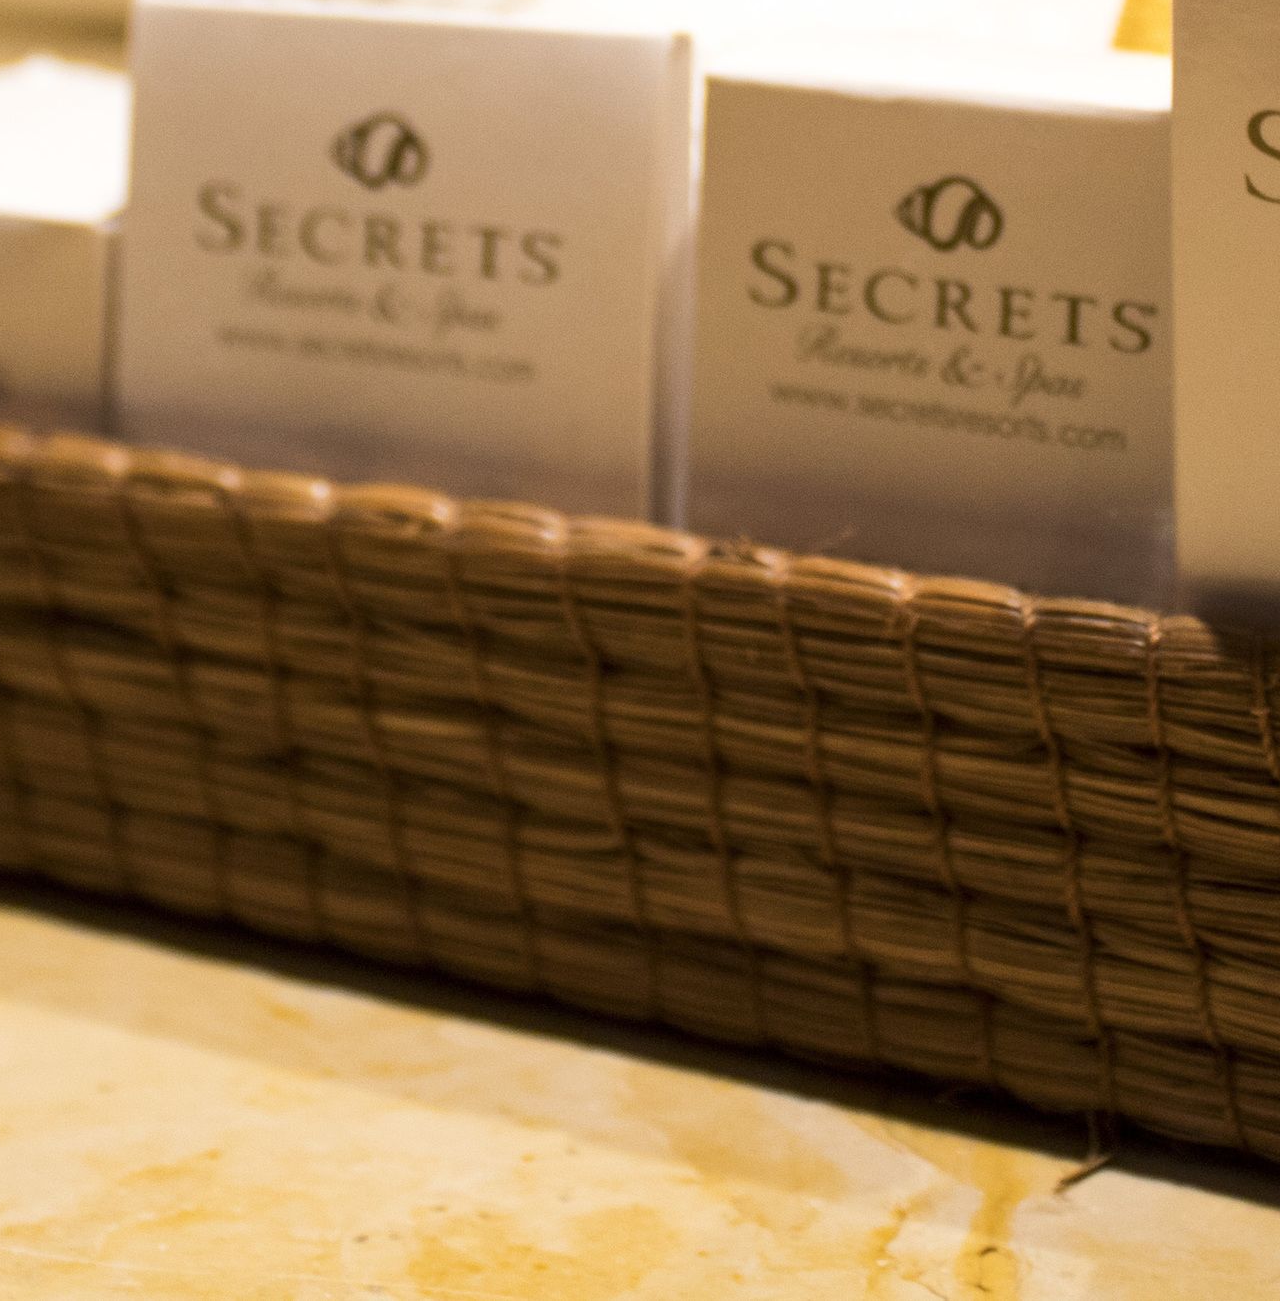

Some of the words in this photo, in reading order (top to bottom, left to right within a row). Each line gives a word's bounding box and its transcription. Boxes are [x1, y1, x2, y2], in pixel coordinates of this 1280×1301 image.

[194, 179, 564, 287] SECRETS
[746, 236, 1160, 355] SECRETS
[940, 345, 984, 390] &
